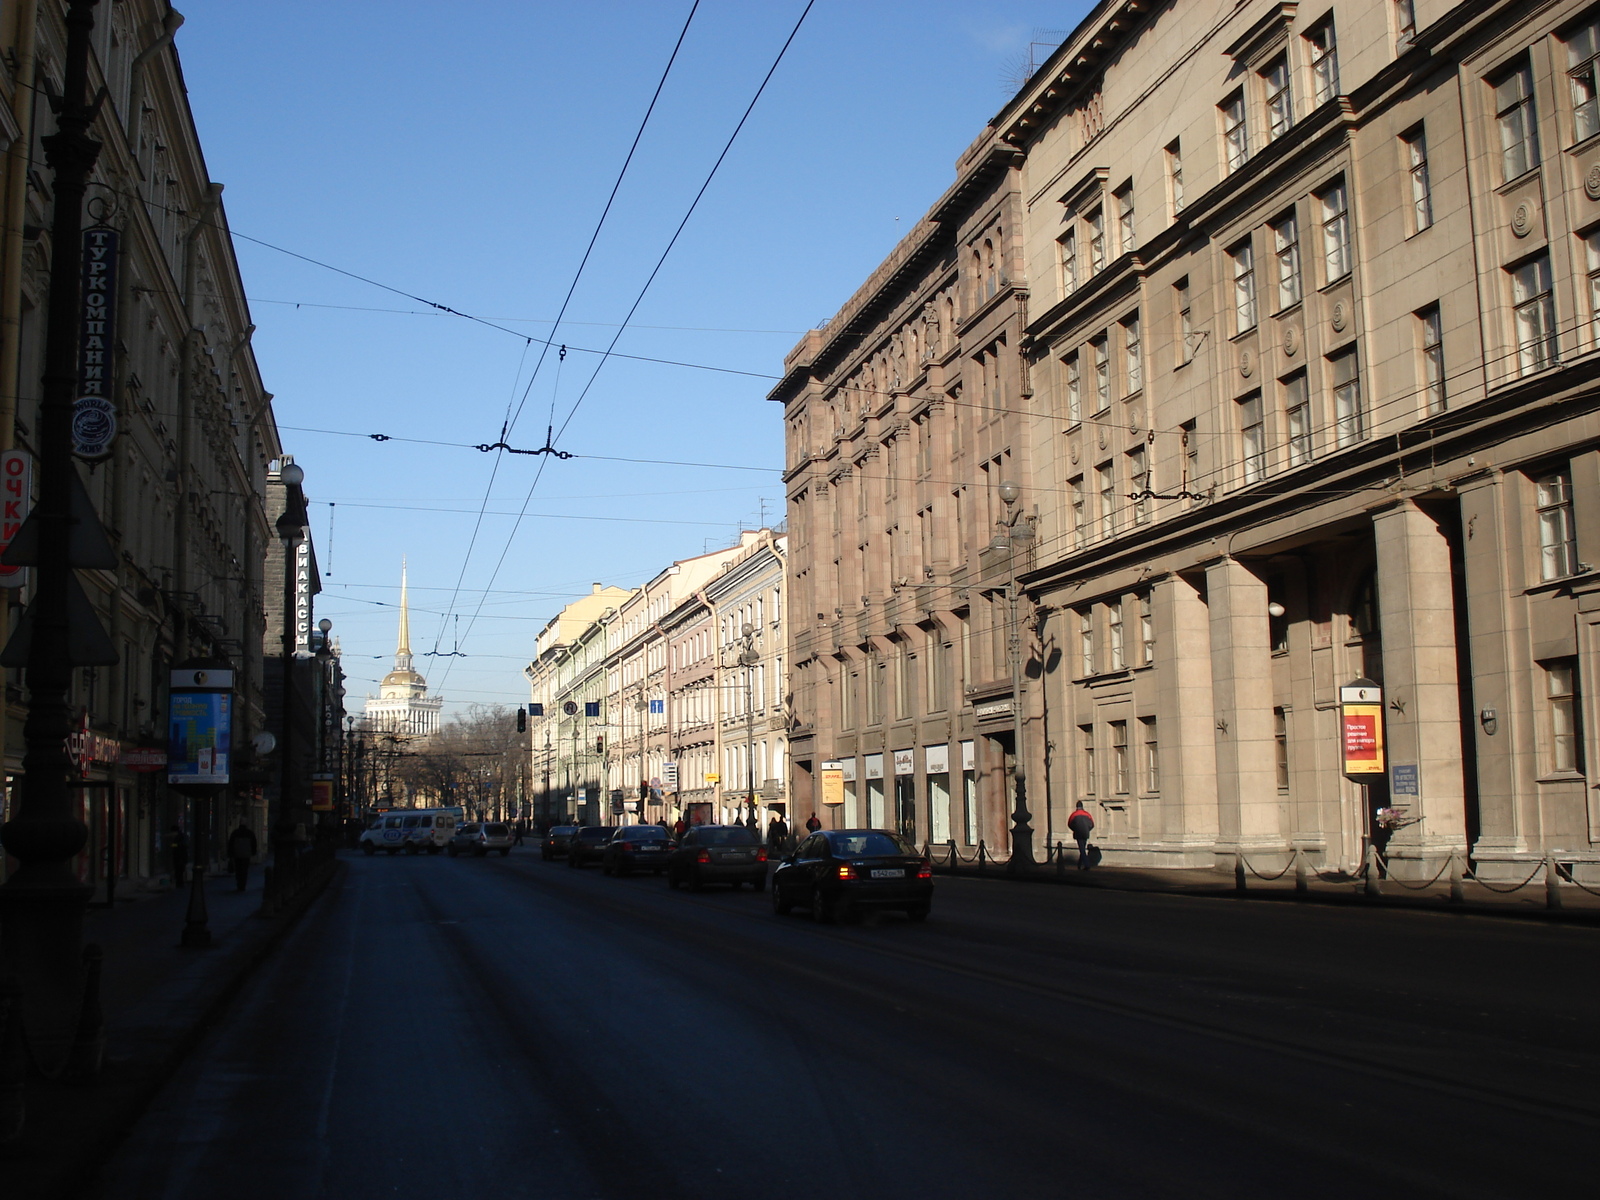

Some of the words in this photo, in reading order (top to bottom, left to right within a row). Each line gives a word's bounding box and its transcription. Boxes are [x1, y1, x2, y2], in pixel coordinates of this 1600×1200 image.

[85, 232, 108, 394] ТУРКОМПАНИЯ
[74, 399, 110, 412] WORLD
[3, 457, 25, 541] ОЧКИ
[173, 696, 193, 704] ГОРОД
